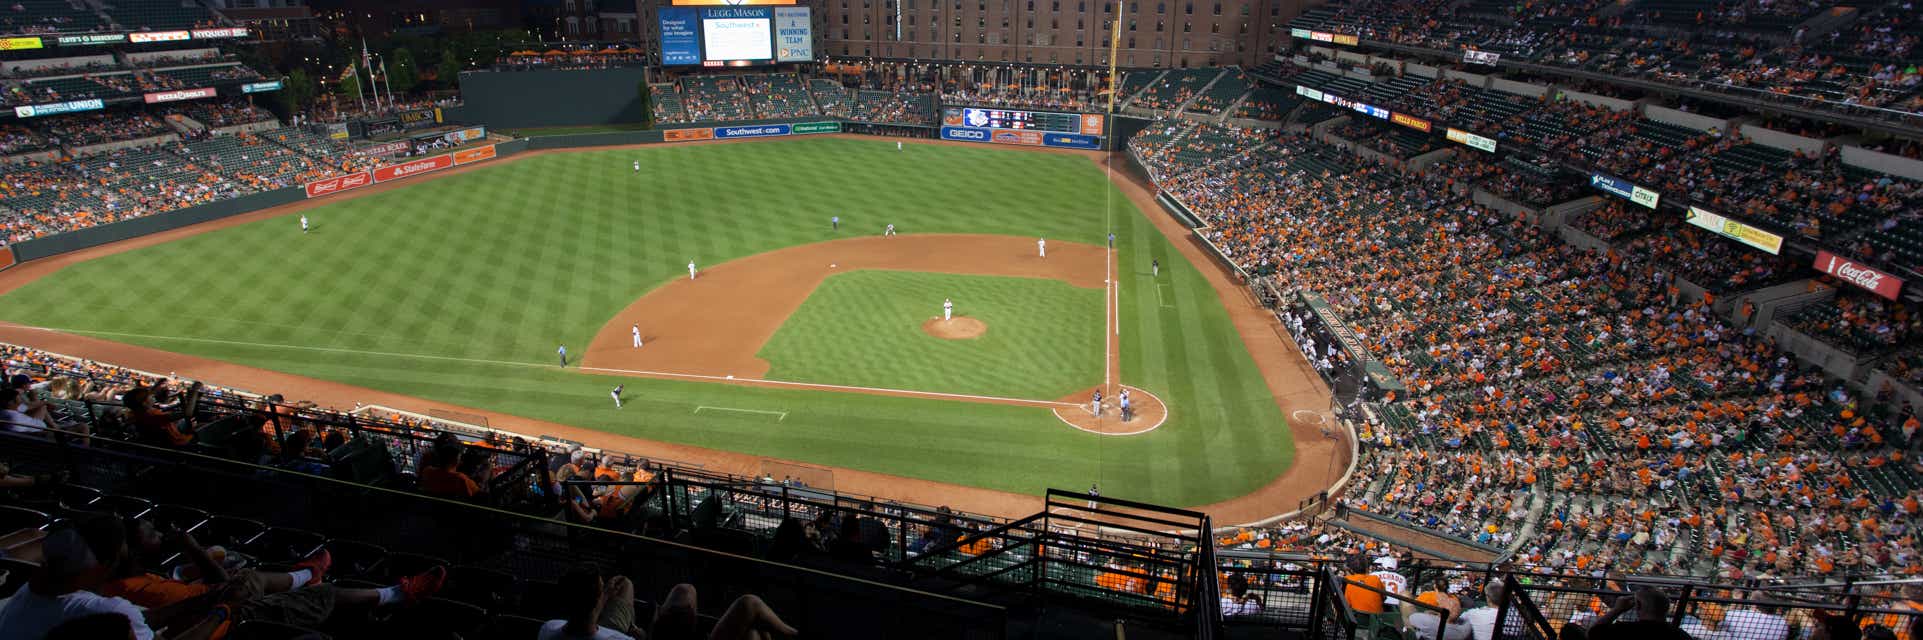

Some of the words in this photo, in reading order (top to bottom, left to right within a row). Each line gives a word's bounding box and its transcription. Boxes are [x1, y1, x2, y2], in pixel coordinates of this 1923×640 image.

[784, 36, 804, 44] TEAM
[790, 48, 808, 57] PNC
[68, 98, 102, 110] UNION
[949, 129, 983, 139] GEICO
